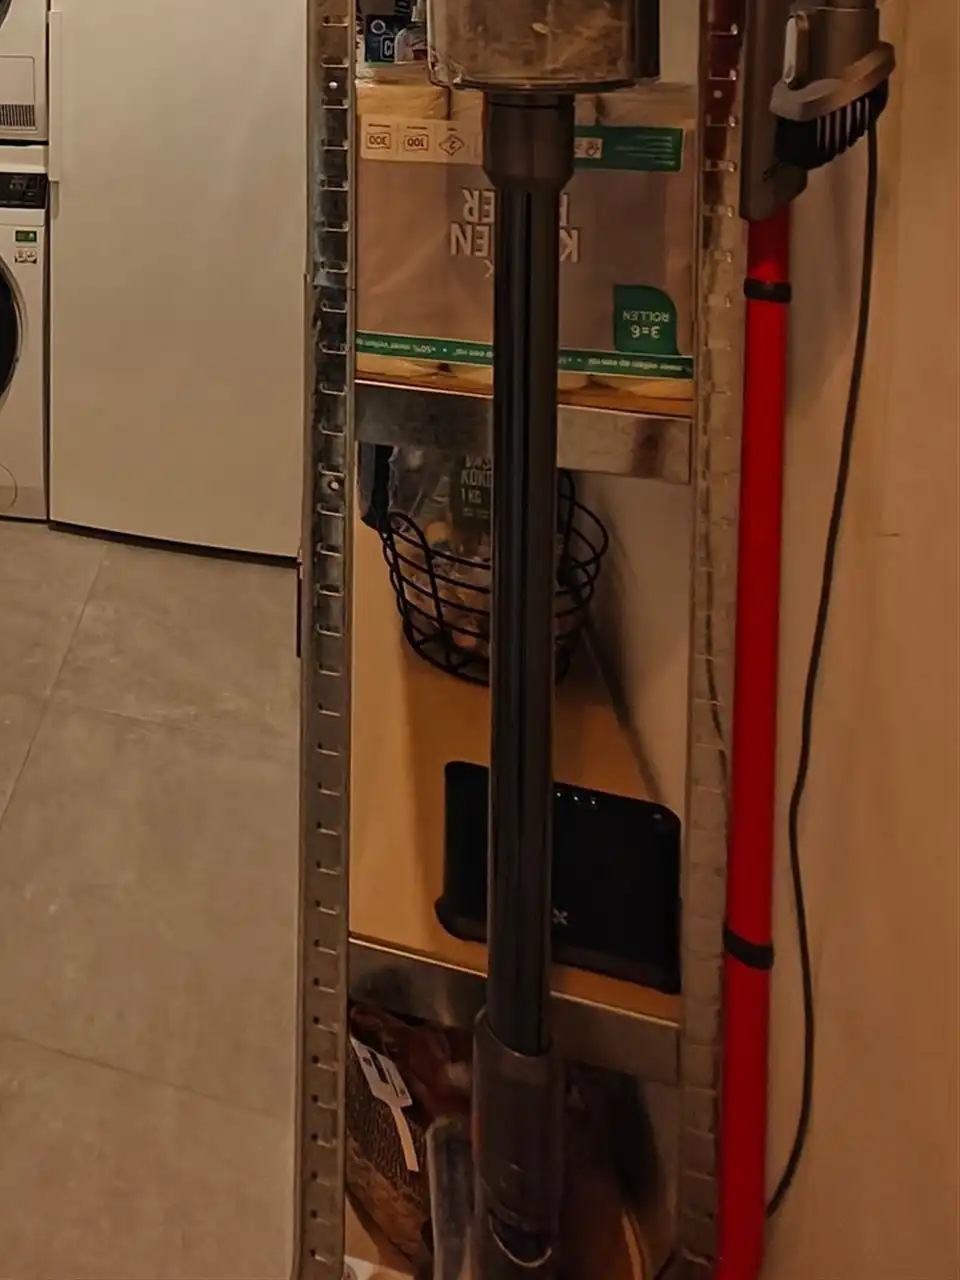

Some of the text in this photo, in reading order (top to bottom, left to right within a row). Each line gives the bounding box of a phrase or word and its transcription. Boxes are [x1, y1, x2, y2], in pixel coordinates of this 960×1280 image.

[406, 137, 426, 148] 100
[622, 310, 670, 324] ROLLEN
[630, 323, 662, 339] 3=6
